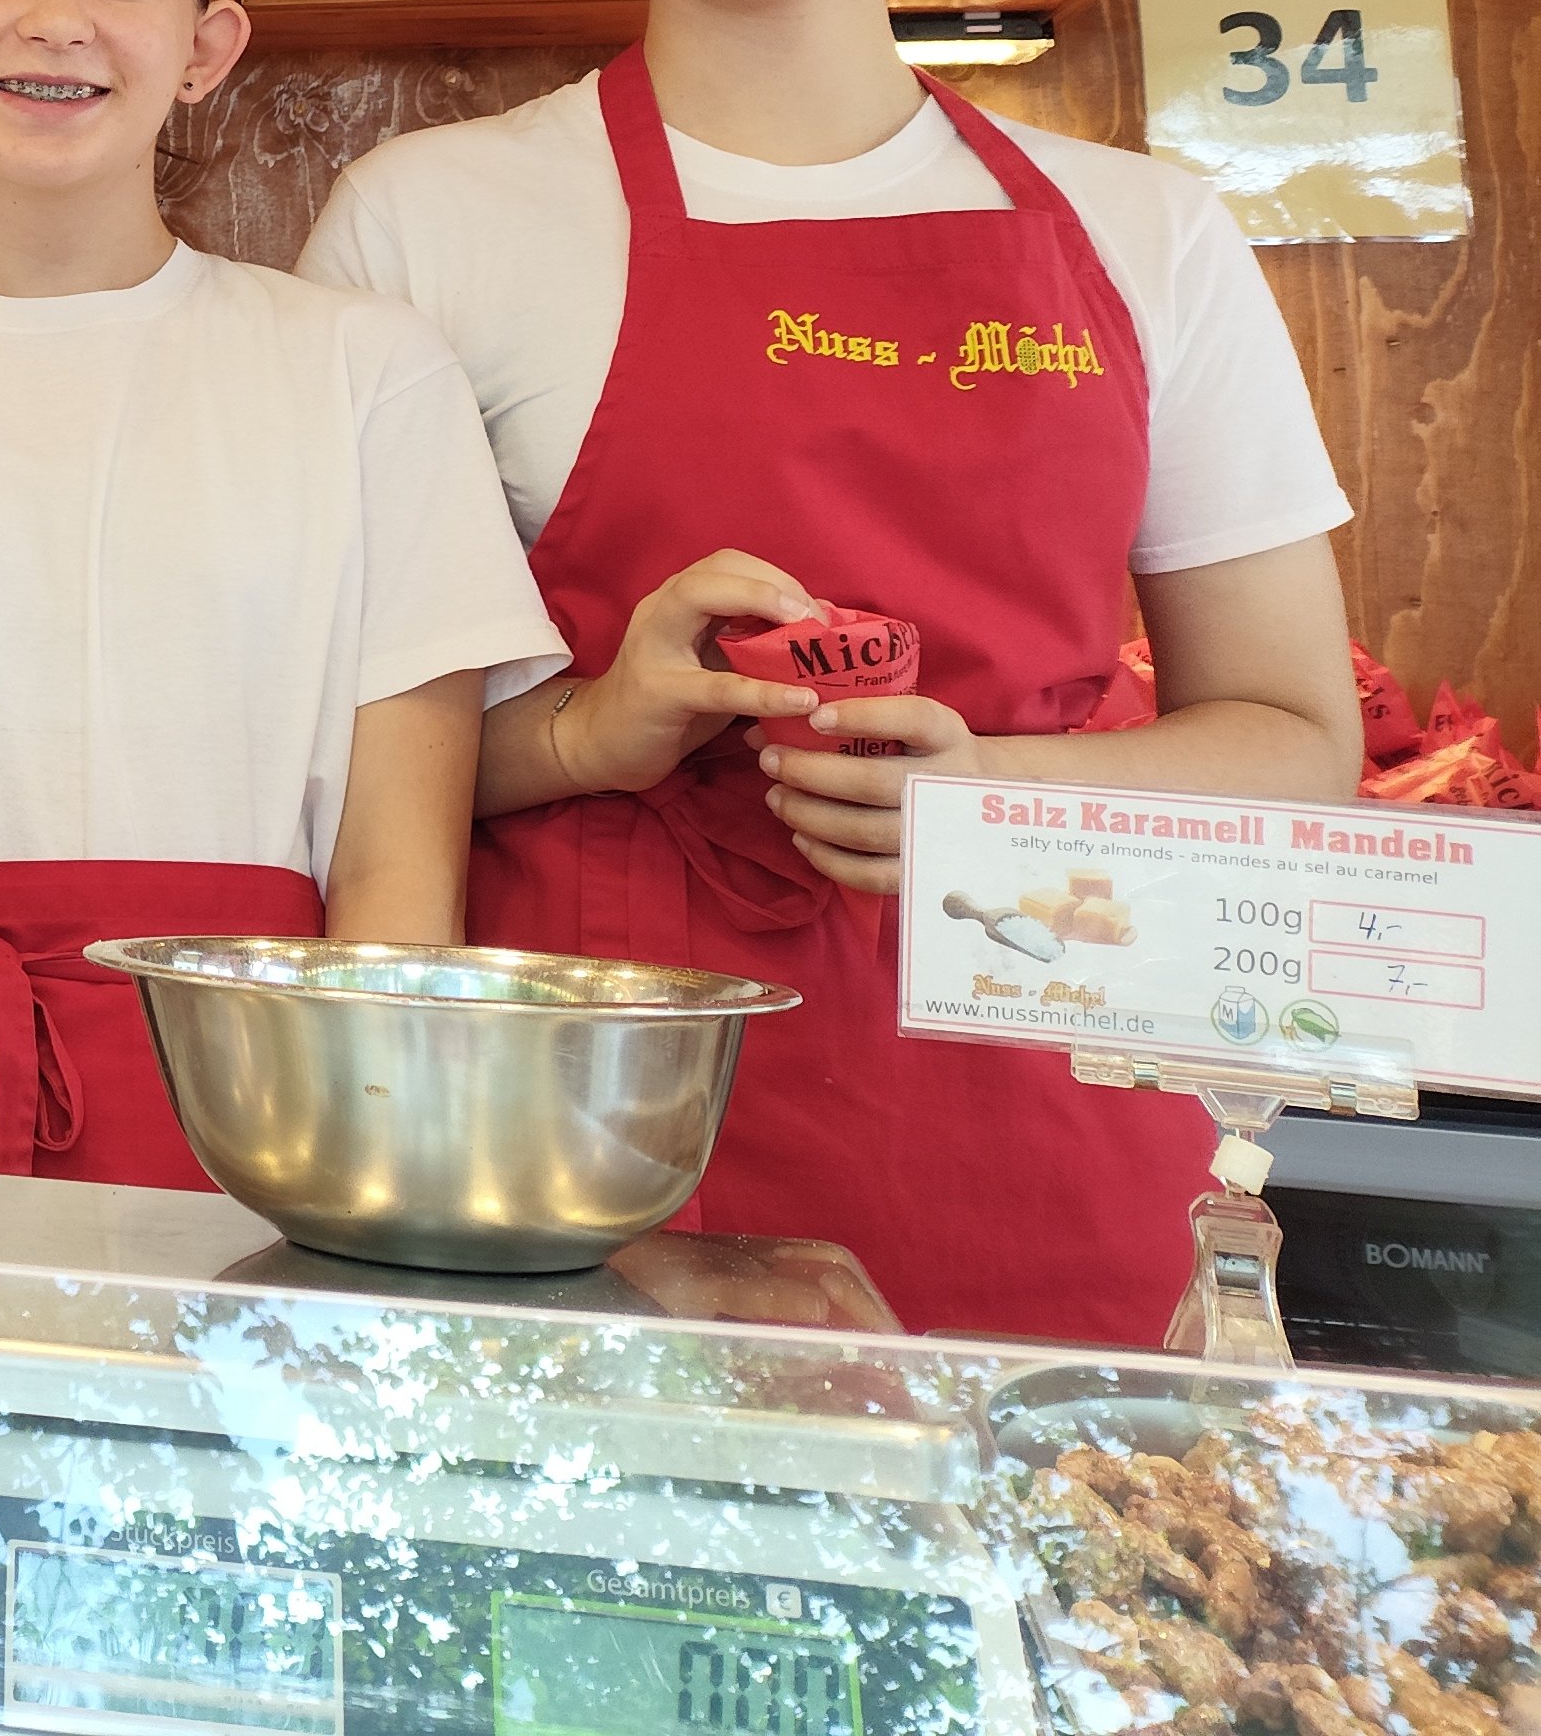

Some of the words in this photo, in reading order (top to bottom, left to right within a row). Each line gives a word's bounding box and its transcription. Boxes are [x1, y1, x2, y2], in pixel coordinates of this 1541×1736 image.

[1219, 8, 1379, 107] 34
[767, 309, 900, 366] Nuss
[981, 793, 1067, 829] Salz
[1080, 802, 1266, 846] Karamell
[1291, 819, 1475, 866] Mandeln
[1011, 835, 1051, 852] salty
[1056, 838, 1095, 856] toffy
[1100, 842, 1174, 861] almonds
[1191, 852, 1271, 869] amandes
[1277, 859, 1298, 872] au
[1305, 861, 1330, 875] sel
[1336, 864, 1358, 878] au
[1364, 867, 1439, 885] caramel
[1216, 897, 1302, 934] 100g
[1213, 946, 1301, 984] 200g
[972, 974, 1023, 1000] Nuss
[926, 999, 1156, 1035] www.nussmichel.de
[1365, 1242, 1490, 1275] BOMANN
[586, 1567, 751, 1611] Gesamtpreis
